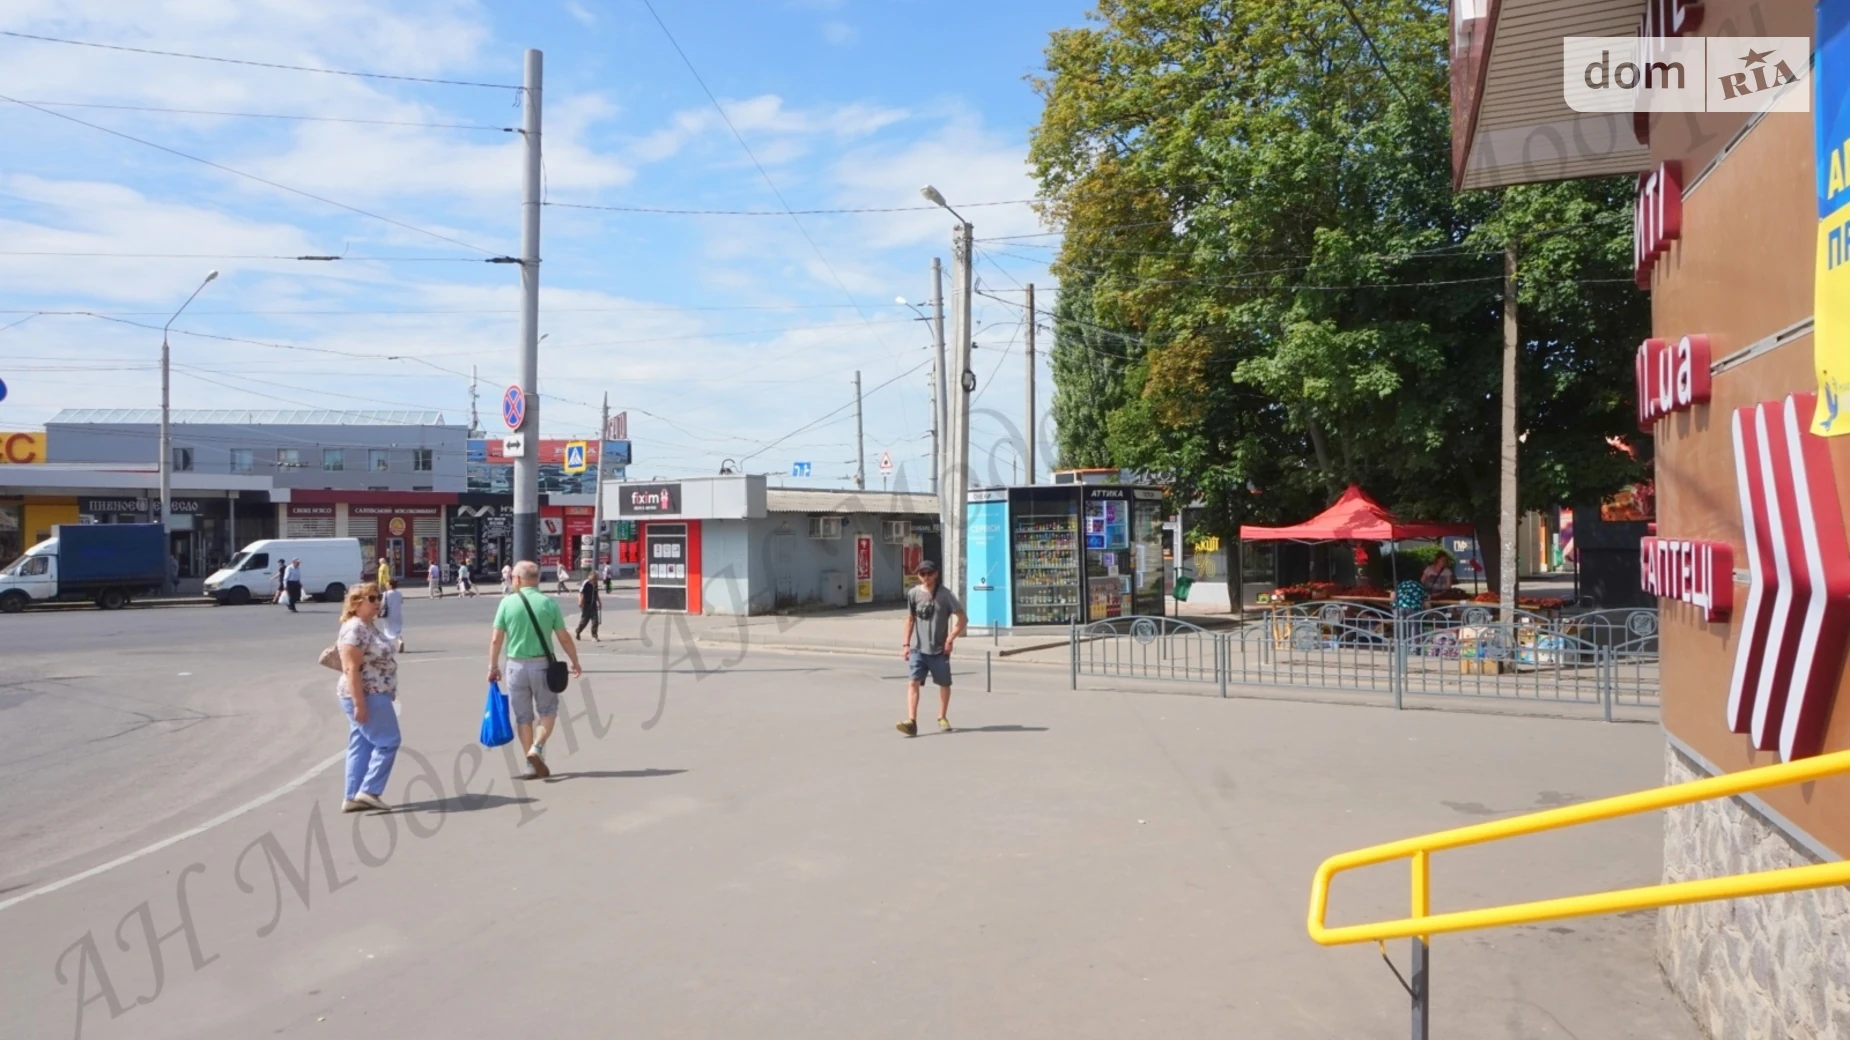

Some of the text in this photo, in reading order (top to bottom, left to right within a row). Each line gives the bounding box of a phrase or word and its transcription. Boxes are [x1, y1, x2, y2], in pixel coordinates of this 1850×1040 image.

[631, 490, 659, 504] fixim
[1090, 489, 1124, 498] АТТИКА
[89, 500, 137, 511] ПИВНОЕ
